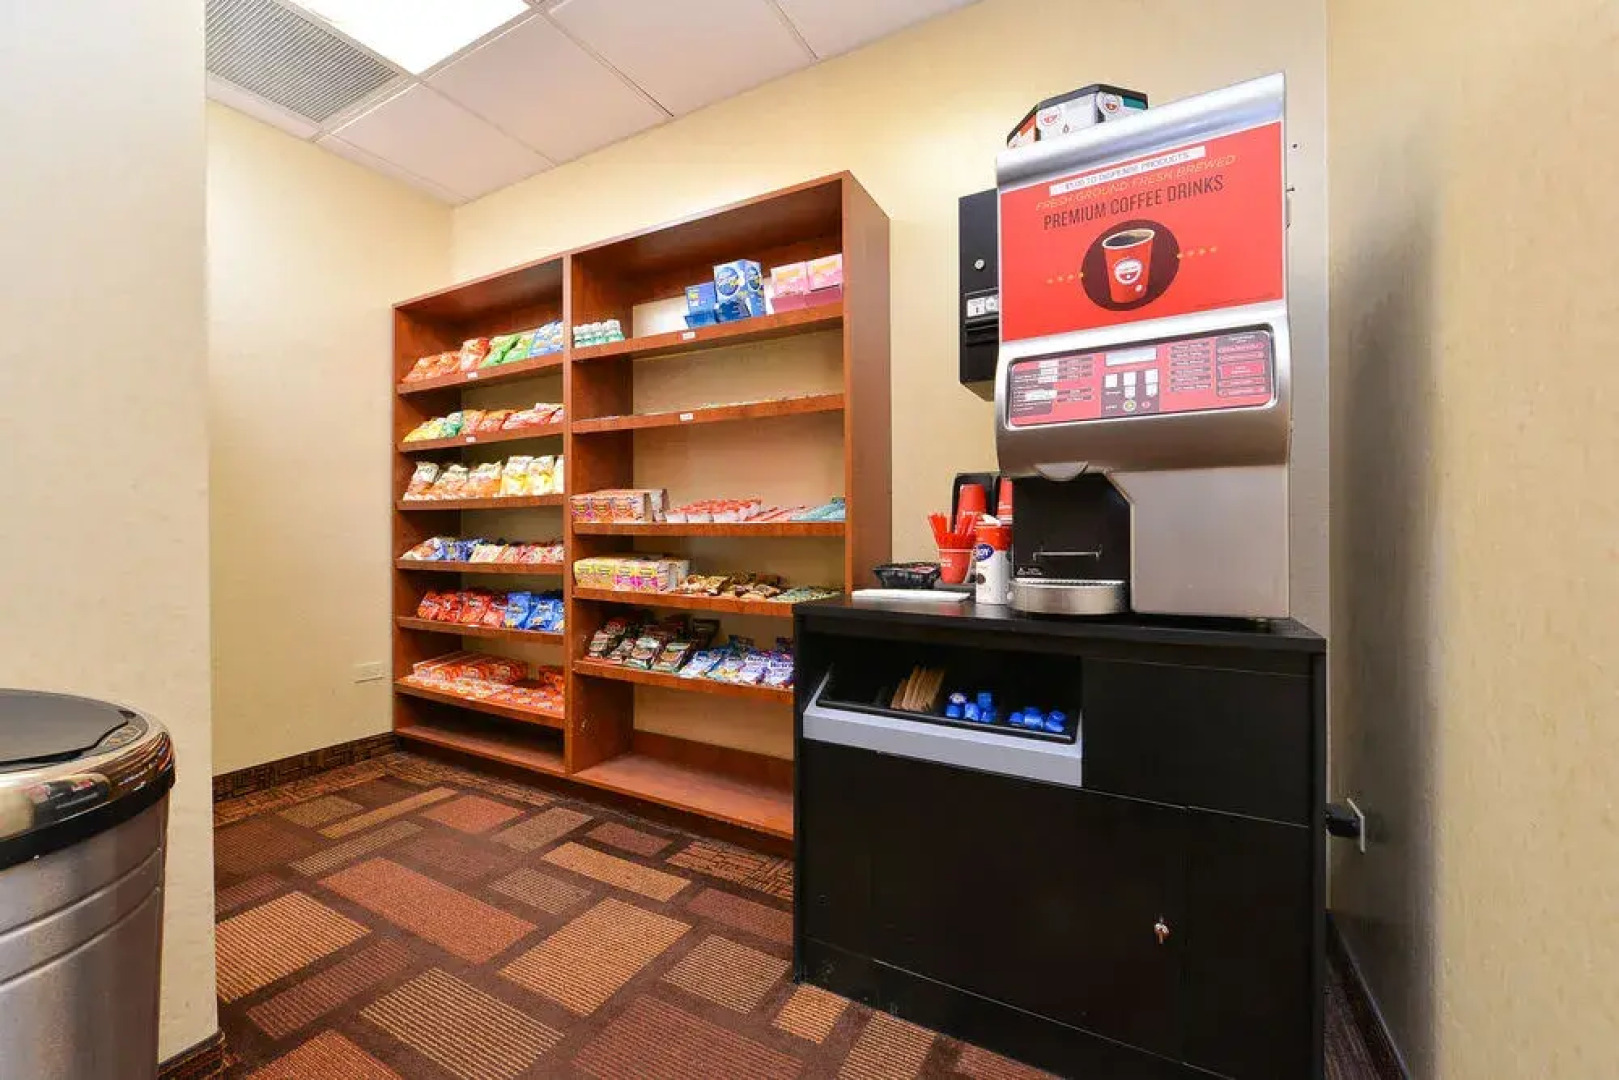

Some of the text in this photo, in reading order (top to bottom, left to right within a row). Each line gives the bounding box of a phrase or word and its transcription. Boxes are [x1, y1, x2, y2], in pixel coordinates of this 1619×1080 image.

[1141, 152, 1189, 171] PRODUCTS
[1043, 174, 1223, 230] PREMIUM COFFEE DRINKS
